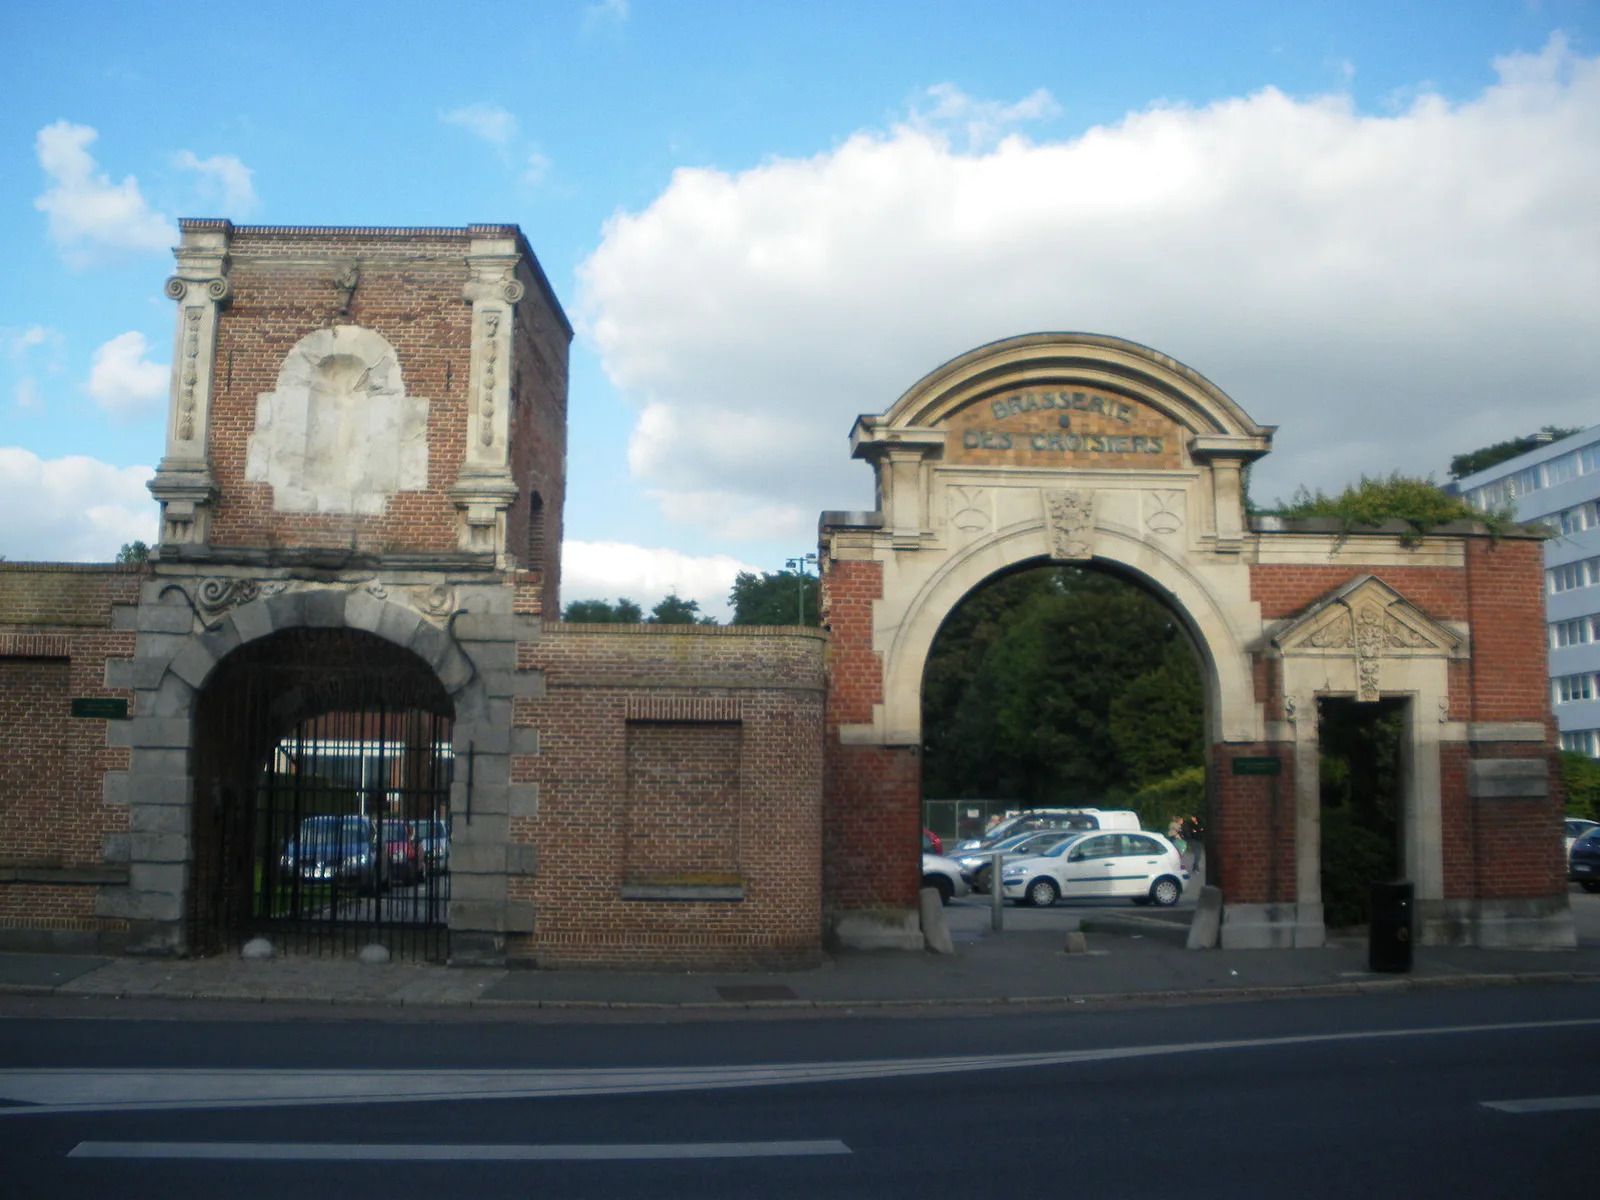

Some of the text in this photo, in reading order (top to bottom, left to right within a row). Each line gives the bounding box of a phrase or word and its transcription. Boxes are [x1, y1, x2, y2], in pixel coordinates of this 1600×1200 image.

[991, 392, 1135, 423] BRASSERIE
[962, 429, 1164, 454] DES CROISIERS
